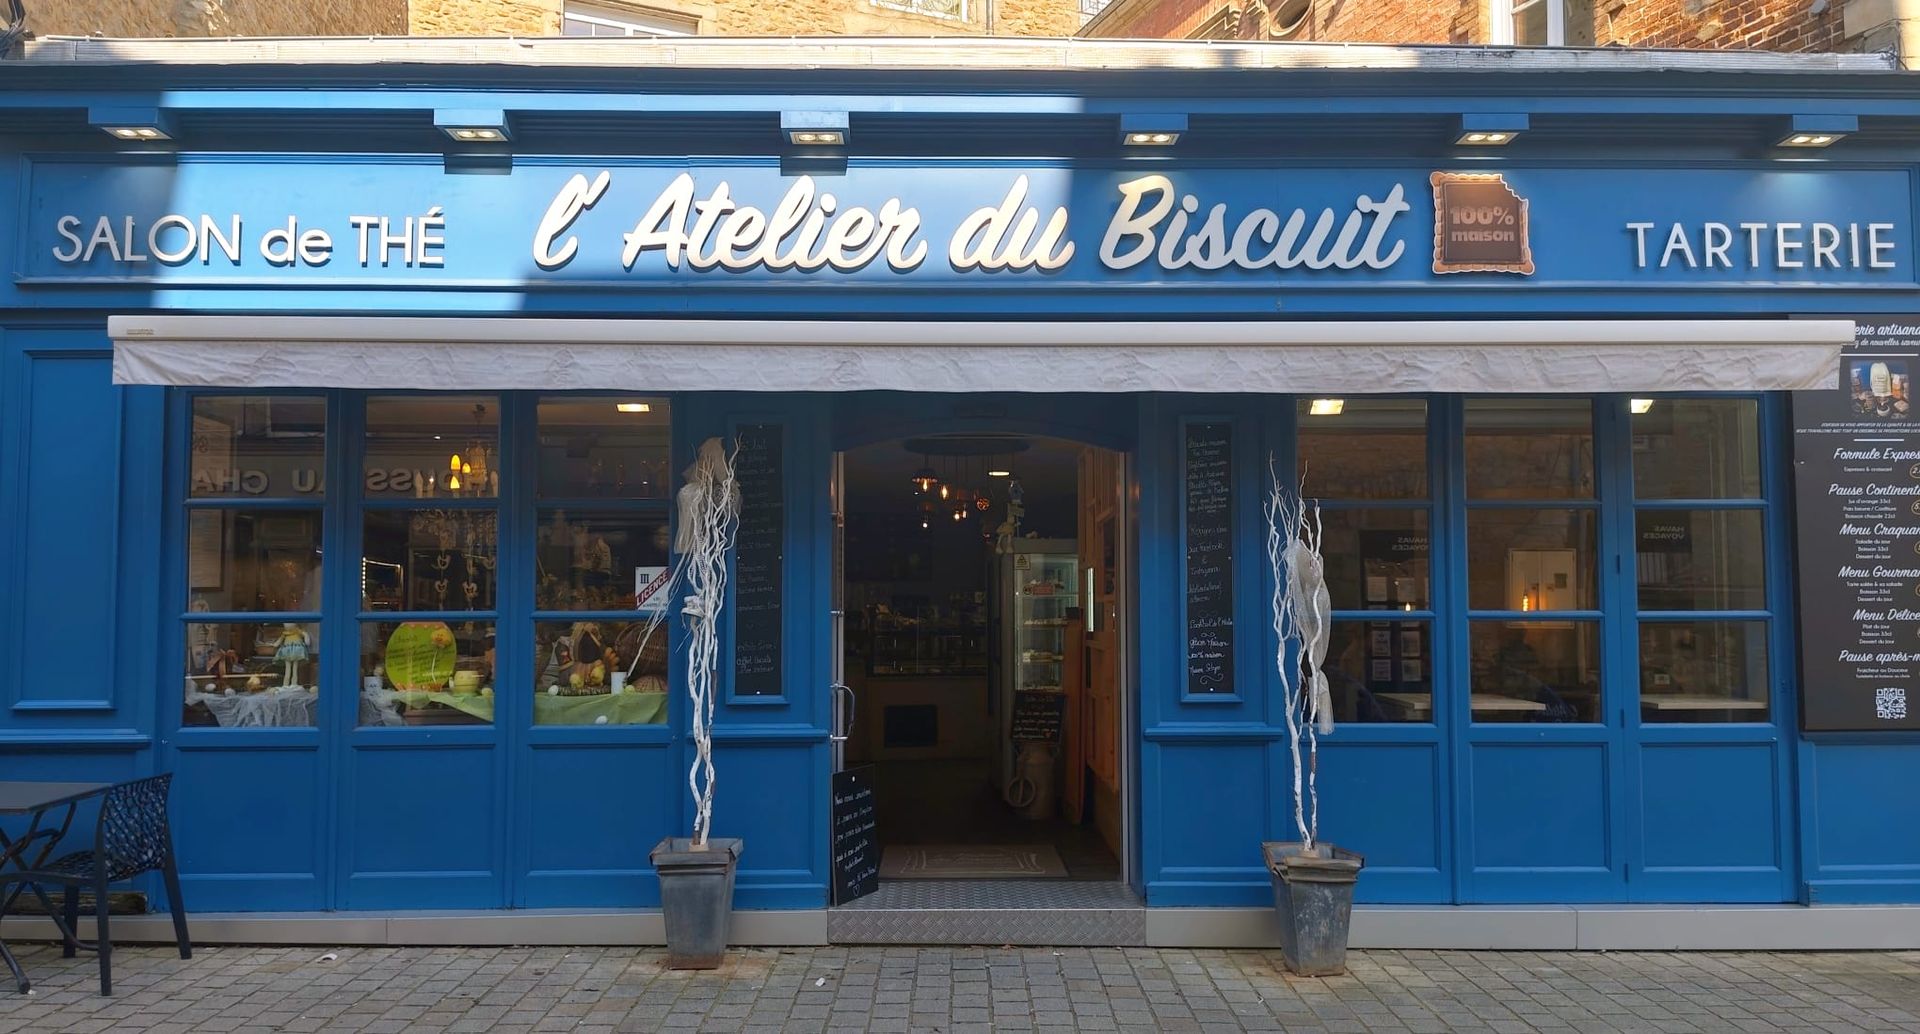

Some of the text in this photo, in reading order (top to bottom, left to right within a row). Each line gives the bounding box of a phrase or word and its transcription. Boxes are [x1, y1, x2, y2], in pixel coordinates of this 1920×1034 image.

[533, 170, 1411, 271] l' Atelier du Biscuit
[1449, 204, 1515, 227] 100%
[52, 206, 446, 266] SALON de THÉ
[1450, 228, 1515, 243] maison
[1626, 222, 1897, 269] TARTERIE
[1870, 338, 1899, 346] nouvelles
[1833, 447, 1881, 460] Formule
[1828, 483, 1920, 496] Pause Continent
[1839, 523, 1872, 536] Menu
[1838, 566, 1870, 578] Menu
[640, 574, 650, 584] III
[636, 570, 669, 607] LICENCE
[1852, 609, 1885, 621] Menu
[1838, 650, 1874, 662] Pause
